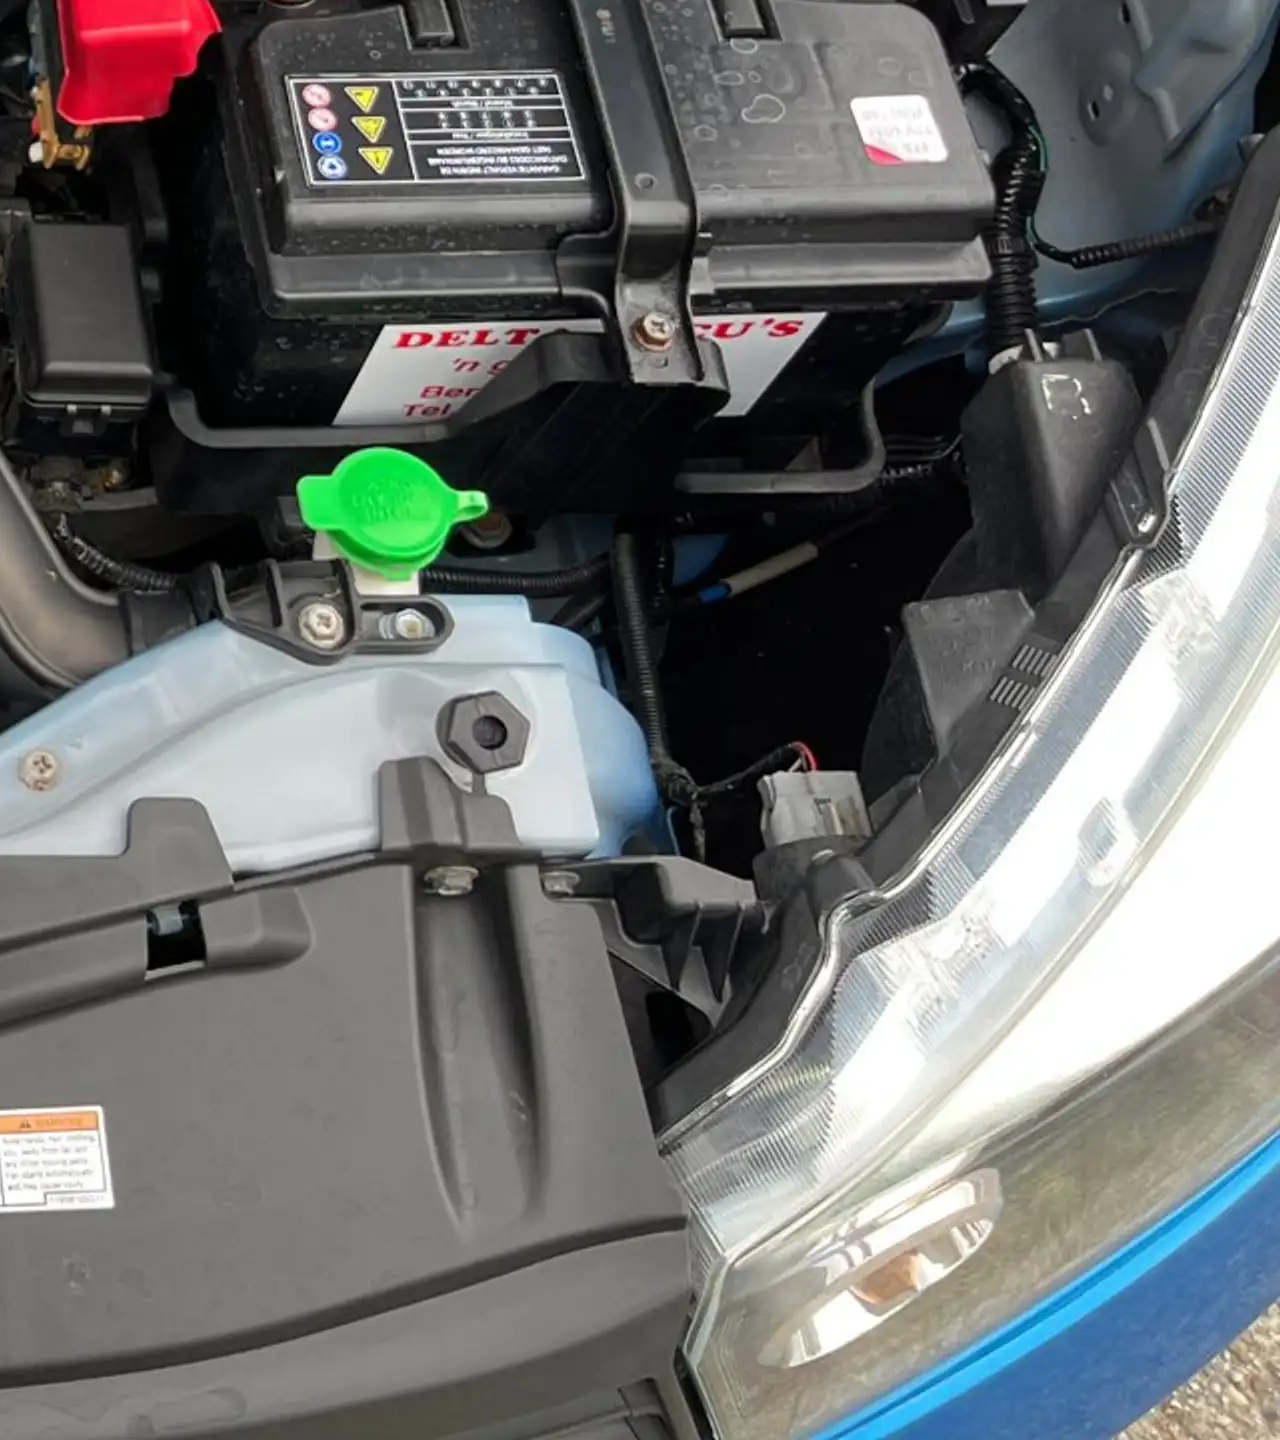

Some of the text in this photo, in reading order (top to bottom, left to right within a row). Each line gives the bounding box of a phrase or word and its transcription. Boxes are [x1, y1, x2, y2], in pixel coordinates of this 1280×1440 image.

[394, 327, 539, 348] DELT
[487, 361, 511, 376] g
[420, 386, 480, 399] Ber
